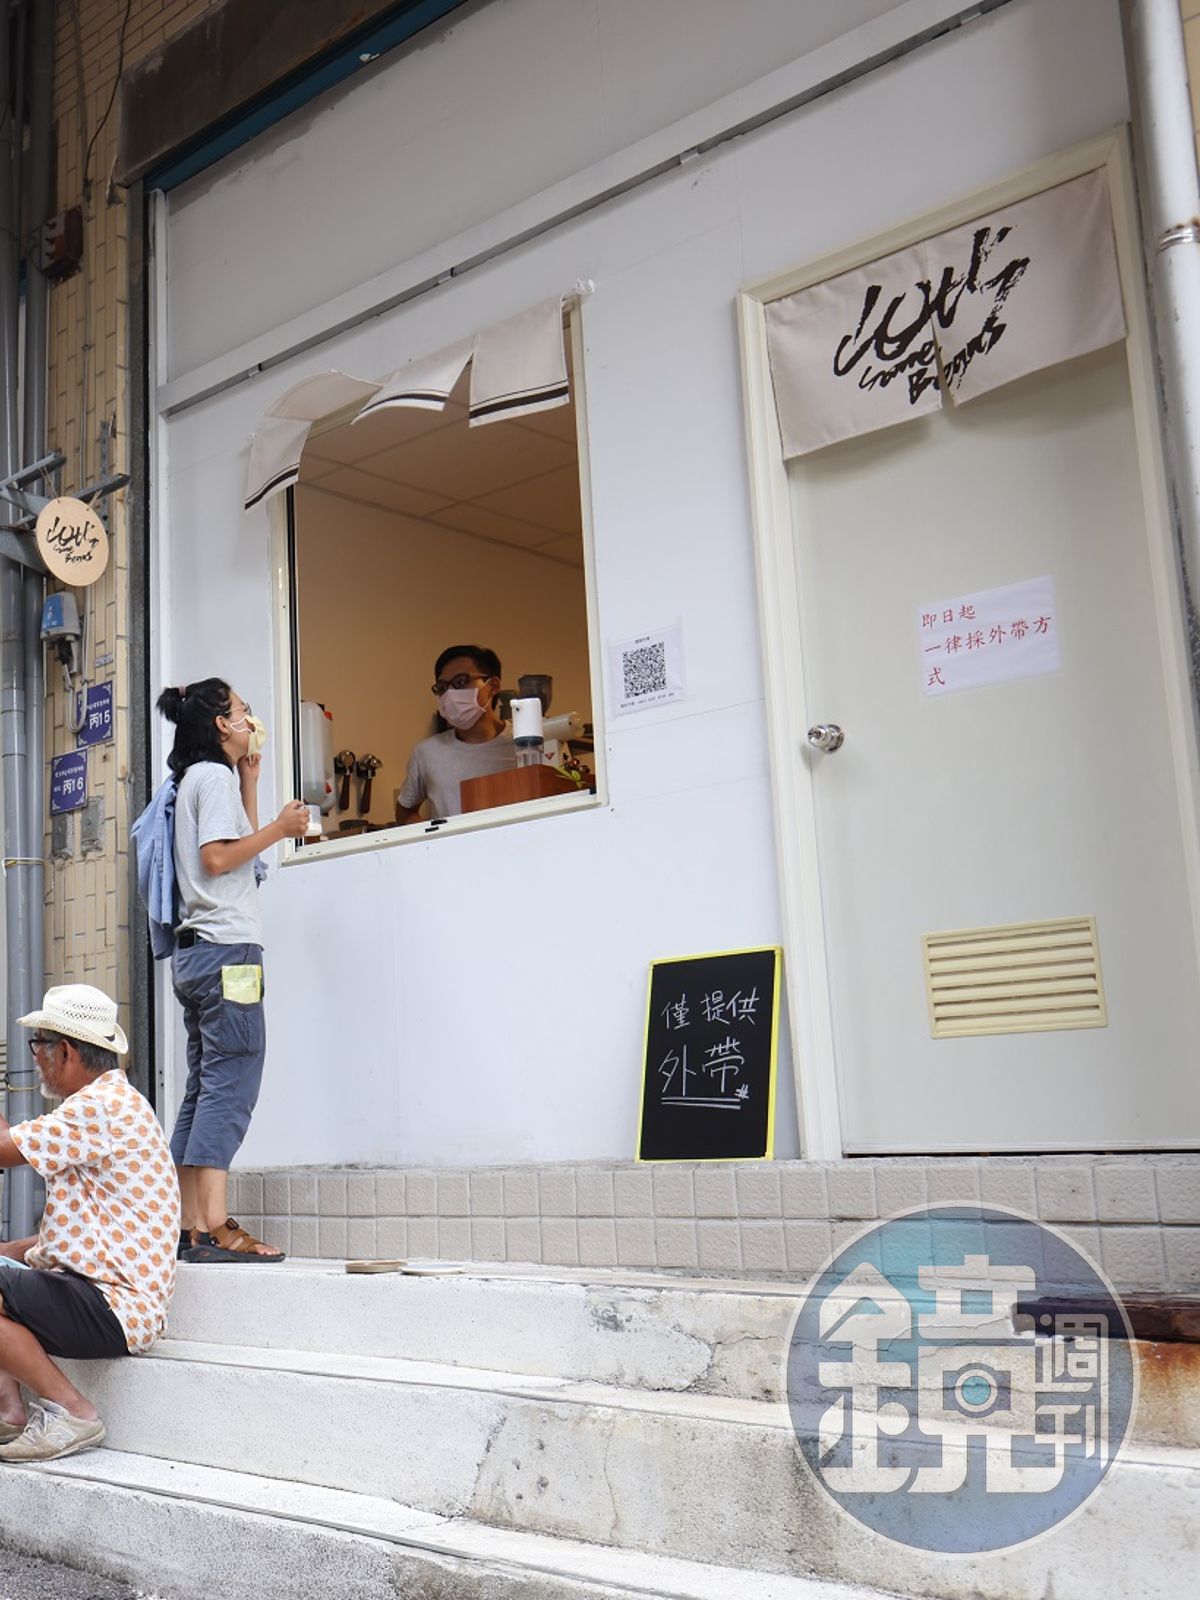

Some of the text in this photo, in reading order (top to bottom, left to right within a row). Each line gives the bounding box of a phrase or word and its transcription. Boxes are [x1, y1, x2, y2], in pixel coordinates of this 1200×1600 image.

[922, 604, 976, 629] 即日起
[924, 616, 1052, 654] 一律採外帶方
[927, 667, 945, 686] 式
[661, 987, 759, 1030] 僅提供
